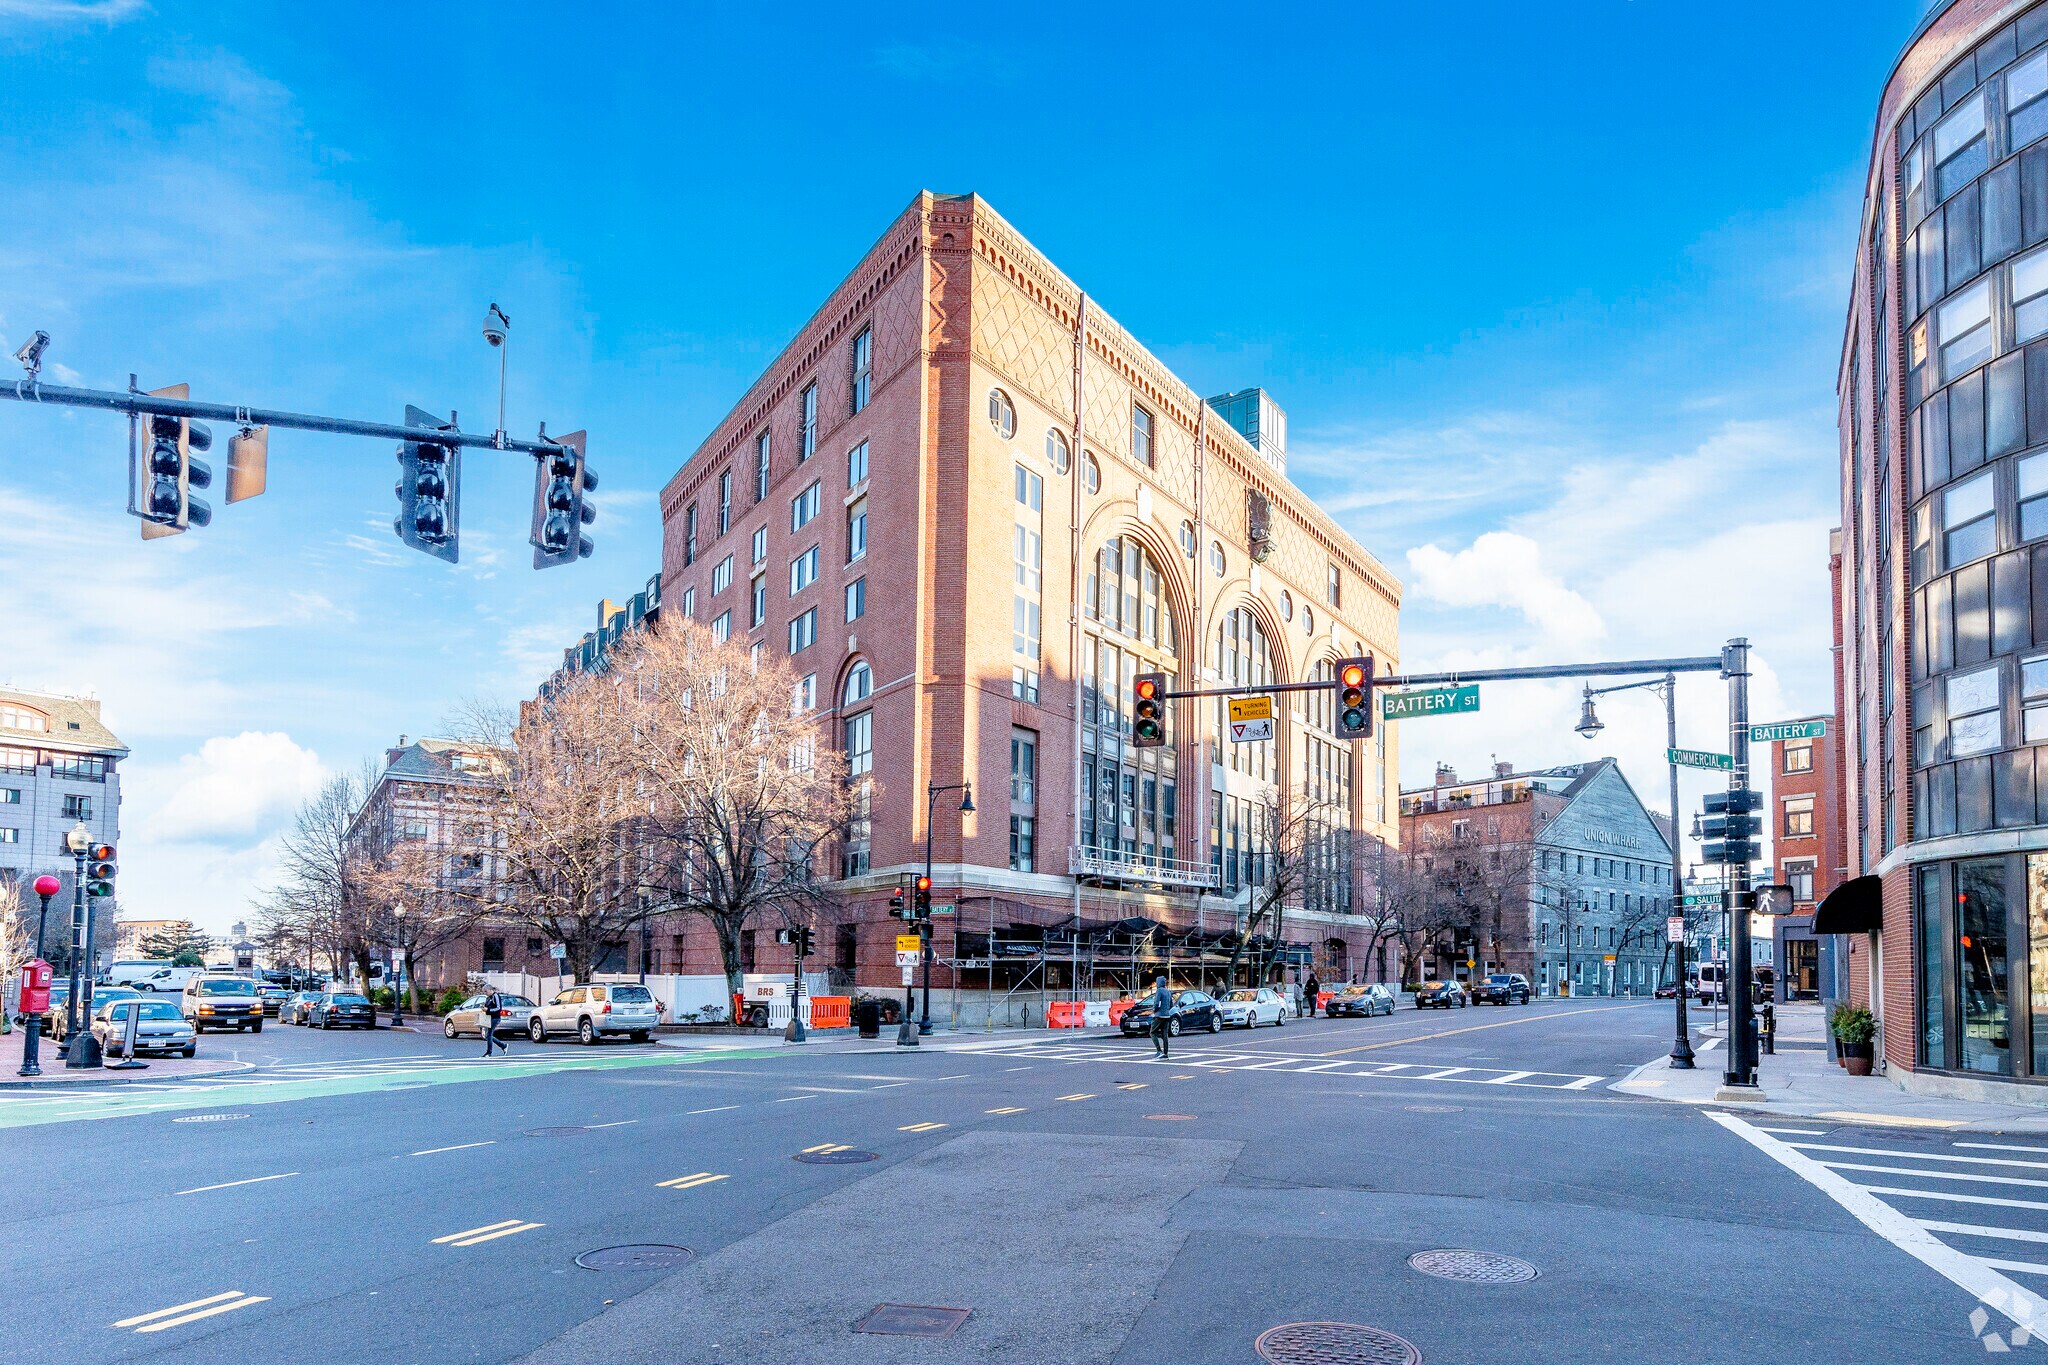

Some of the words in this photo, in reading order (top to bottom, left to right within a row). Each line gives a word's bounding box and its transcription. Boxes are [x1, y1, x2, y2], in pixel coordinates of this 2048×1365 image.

[1244, 701, 1267, 709] TURNING
[1385, 692, 1457, 714] BATTERY
[1464, 695, 1477, 706] ST
[1244, 708, 1269, 716] VEHICLES
[1755, 724, 1808, 740] BATTERY
[1813, 728, 1821, 736] ST
[1672, 750, 1720, 767] COMMERCIAL
[1583, 827, 1611, 844] UNION
[1611, 832, 1641, 850] WHARF
[757, 987, 774, 996] BRS
